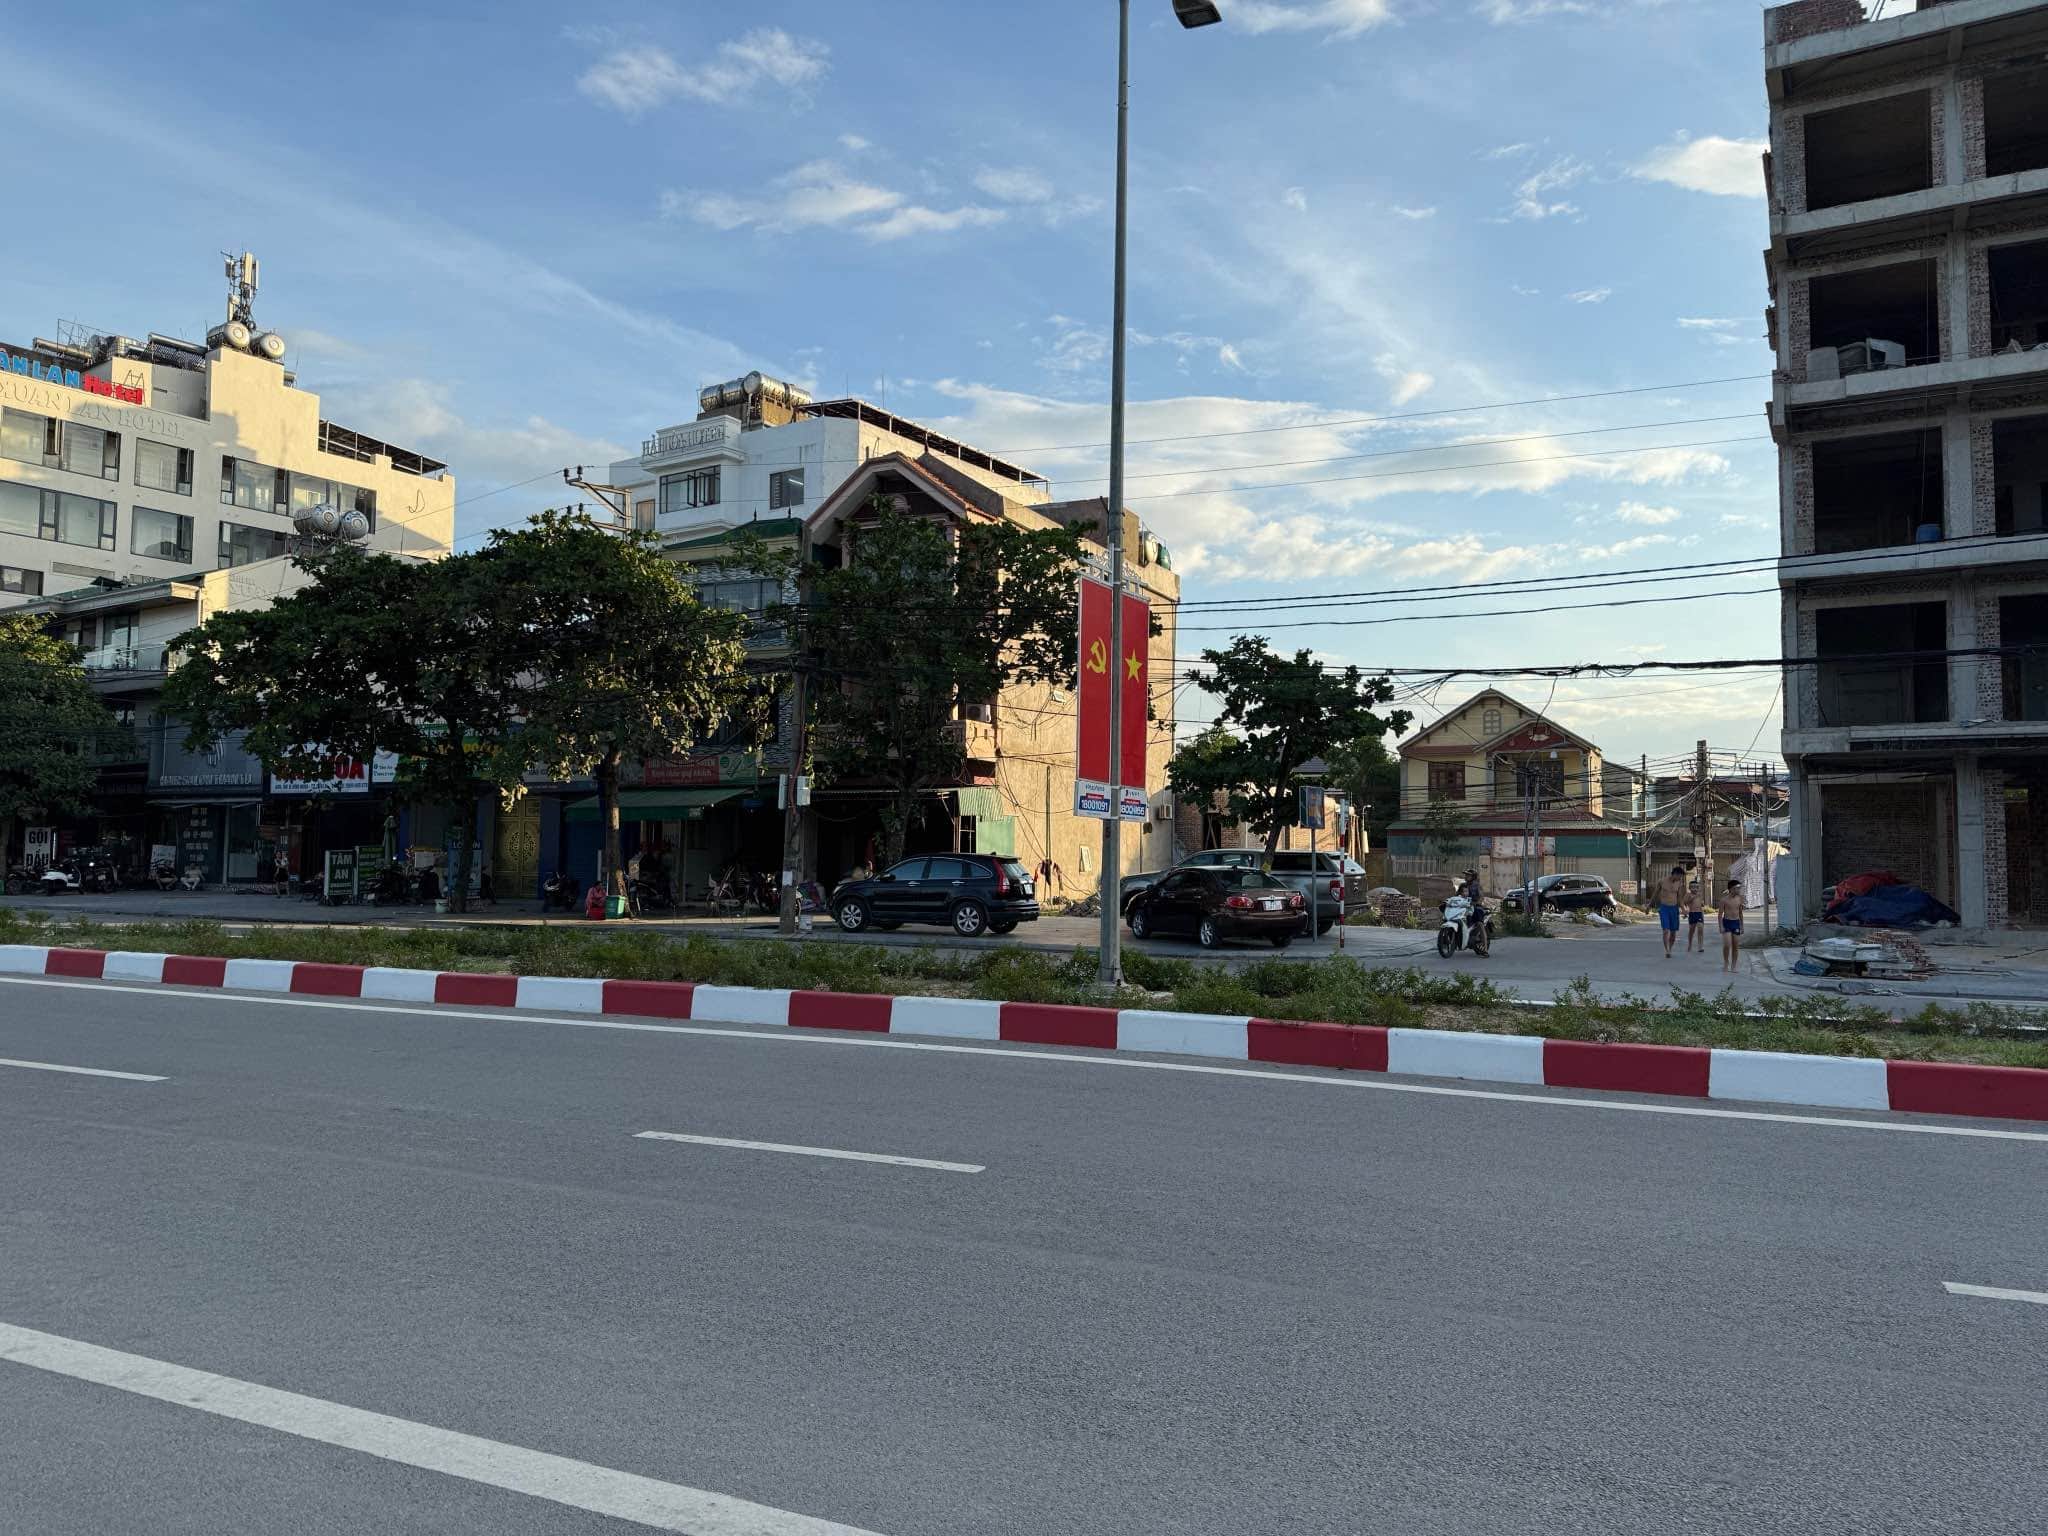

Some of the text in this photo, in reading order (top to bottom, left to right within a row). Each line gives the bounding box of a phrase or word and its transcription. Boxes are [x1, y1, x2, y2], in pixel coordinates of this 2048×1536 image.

[32, 360, 81, 389] LAN
[83, 372, 143, 406] Hotel
[1081, 799, 1109, 812] 18001091
[334, 868, 349, 881] AN
